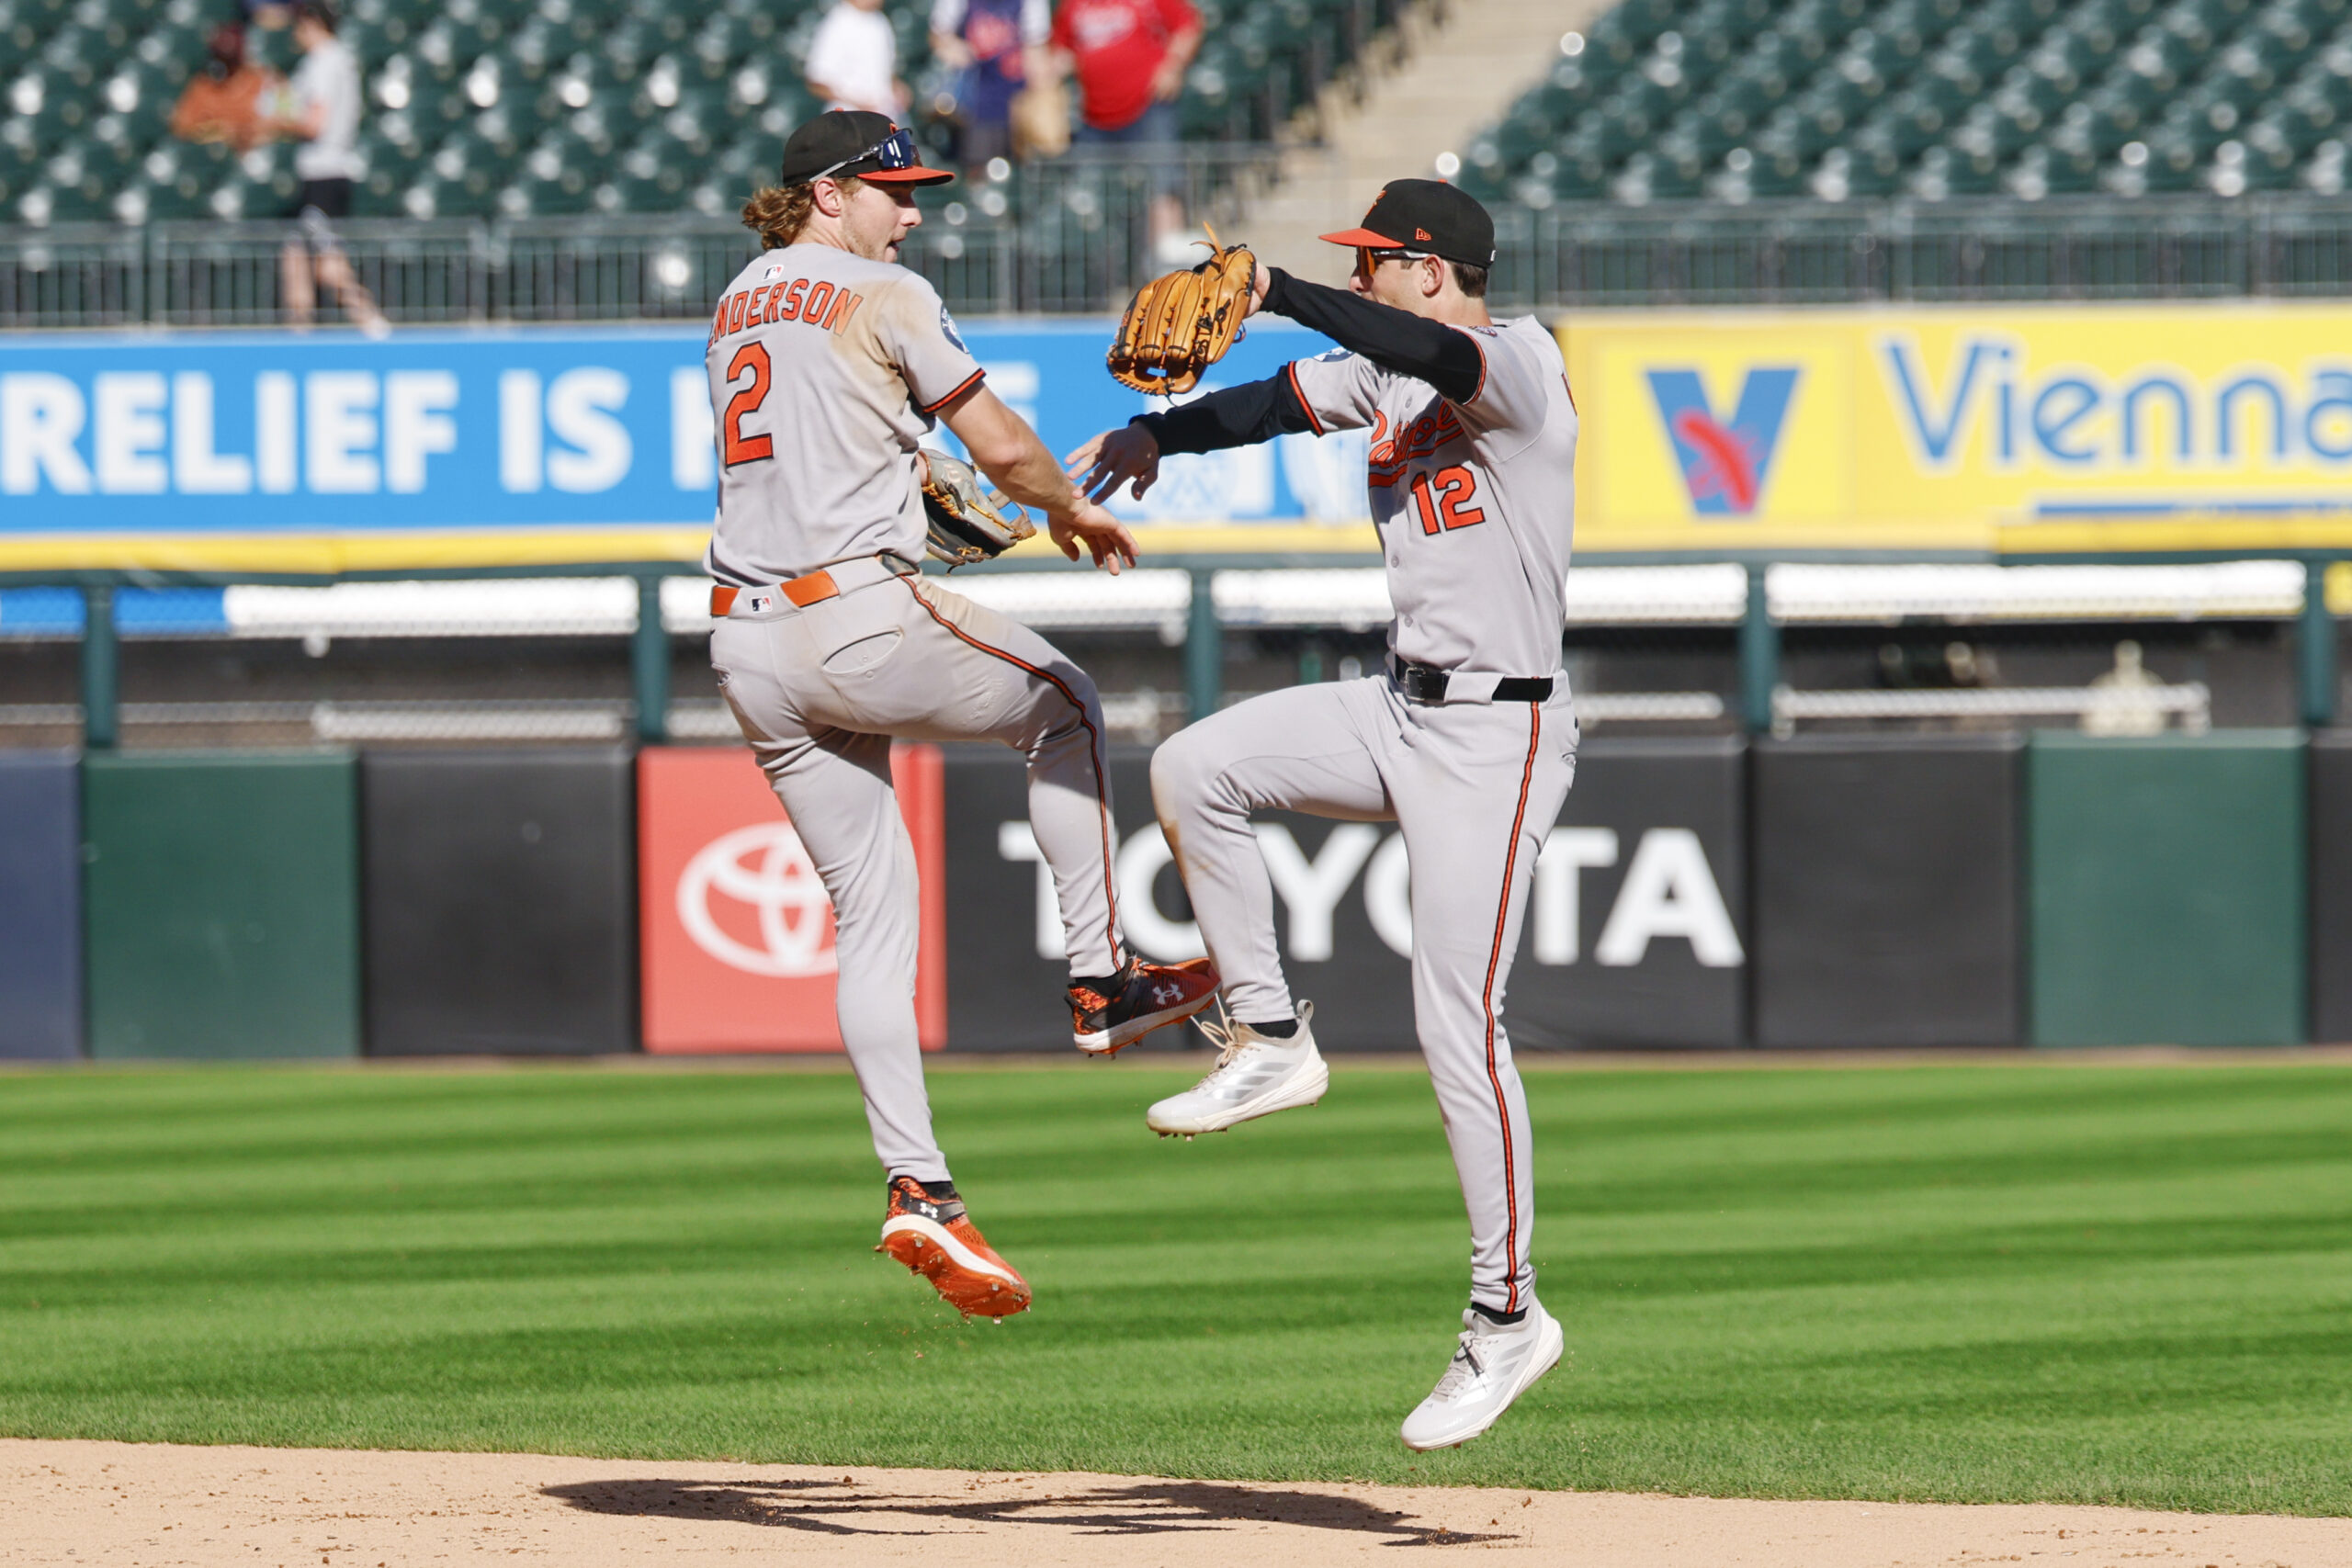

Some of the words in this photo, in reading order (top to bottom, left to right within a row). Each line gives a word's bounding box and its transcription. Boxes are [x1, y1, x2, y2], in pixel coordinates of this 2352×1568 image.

[707, 278, 864, 349] NDERSON
[0, 368, 459, 495] RELIEF
[498, 366, 633, 493] IS
[723, 340, 775, 468] 2
[1888, 336, 2352, 462] Vienna
[1410, 464, 1486, 536] 12
